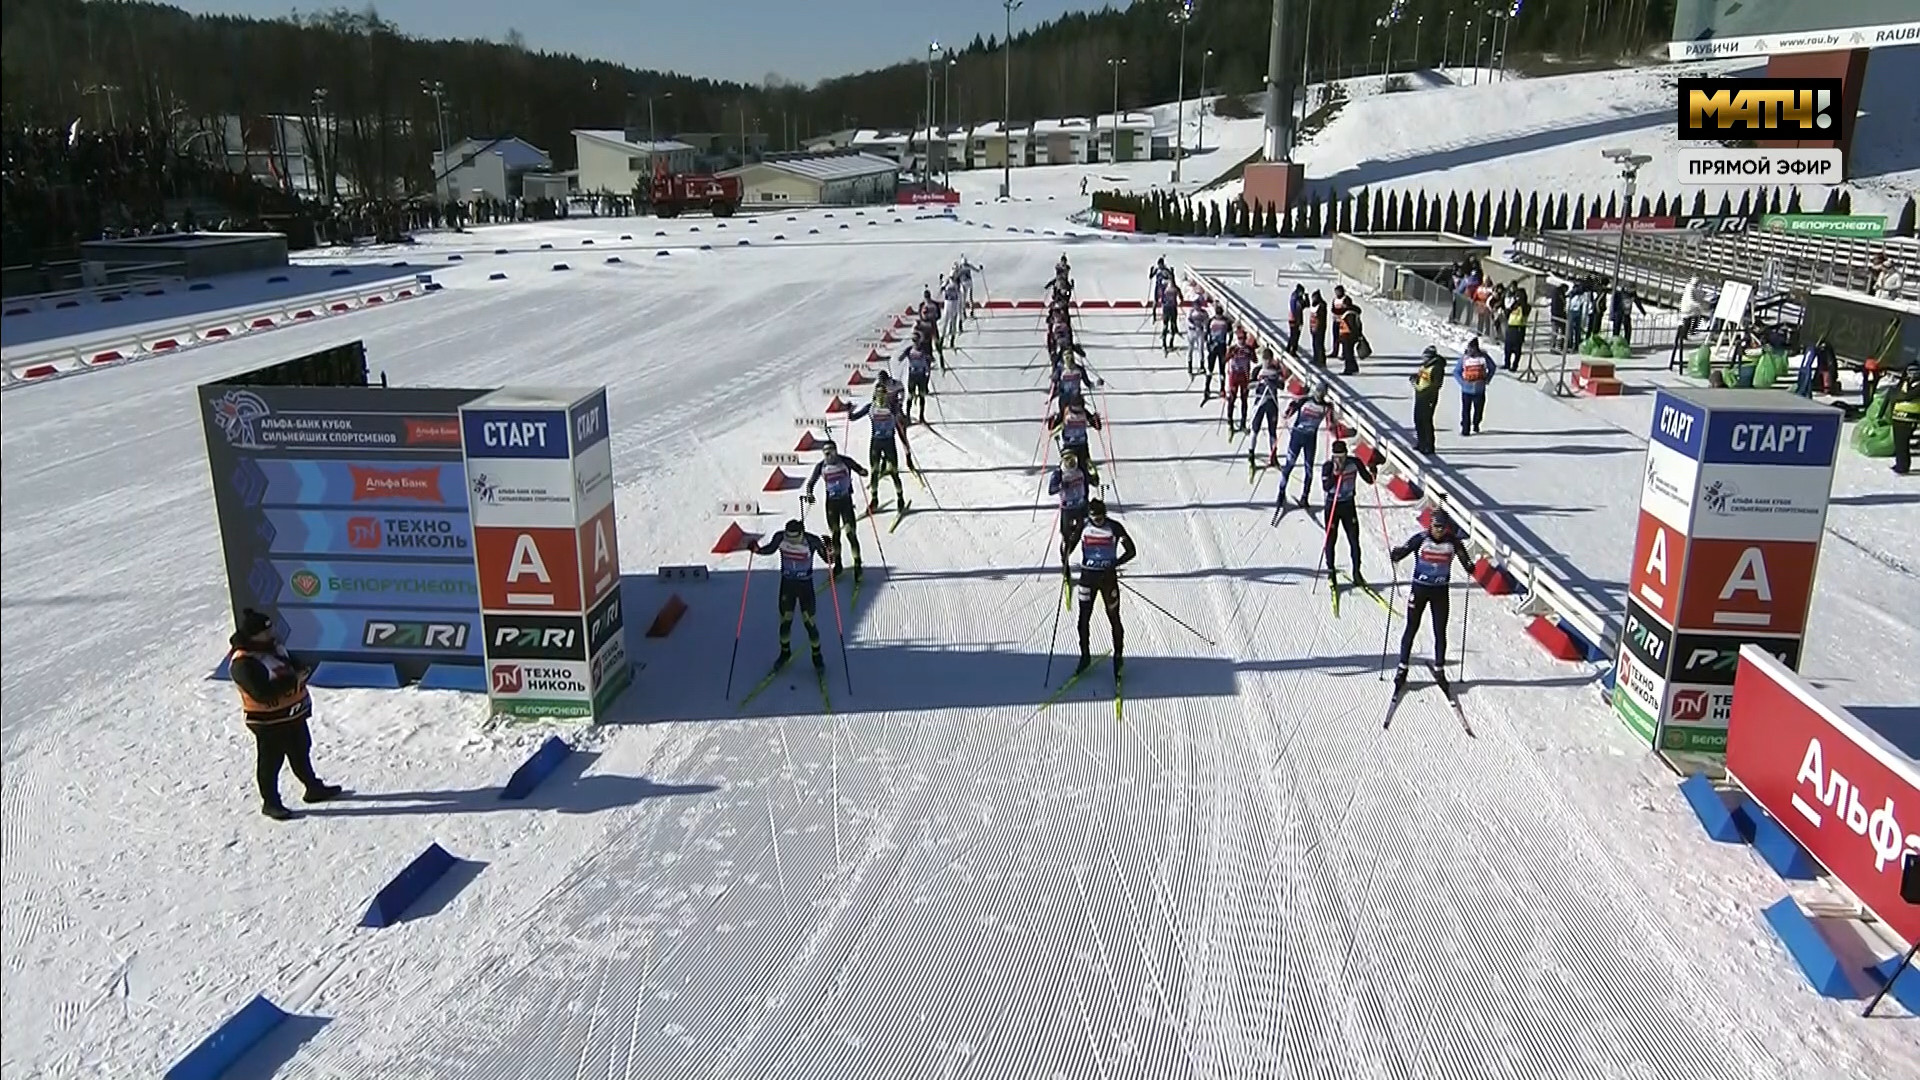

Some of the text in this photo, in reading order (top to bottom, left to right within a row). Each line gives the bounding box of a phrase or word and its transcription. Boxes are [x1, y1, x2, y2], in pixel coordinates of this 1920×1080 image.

[1779, 34, 1839, 48] www.rau.by
[1685, 42, 1739, 55] РАУБИЧИ
[1792, 220, 1881, 231] БЕЛОРУСНЕФТЬ
[261, 419, 352, 430] АЛЬФА-БАНК КУБОК
[577, 406, 600, 441] СТАРТ
[1660, 405, 1694, 443] СТАРТ
[263, 430, 397, 444] СИЛЬНЕЙШИХ СПОРТСМЕНОВ
[483, 421, 547, 448] СТАРТ
[1731, 424, 1812, 453] СТАРТ
[366, 477, 428, 489] Альфа Банк
[722, 504, 752, 512] 7 8 9
[384, 519, 451, 533] ТЕХНО
[387, 534, 467, 549] НИКОЛЬ
[328, 576, 477, 595] БЕЛОРУСНЕФТЬ
[366, 622, 466, 648] PARI
[495, 628, 575, 648] PARI
[1626, 614, 1664, 660] PARI
[525, 668, 572, 679] ТЕХНО
[1631, 666, 1654, 692] ТЕХНО
[528, 680, 586, 692] НИКОЛЬ
[1630, 681, 1659, 710] НИКОЛЬ
[515, 705, 591, 716] БЕЛОРУСНЕФТЬ
